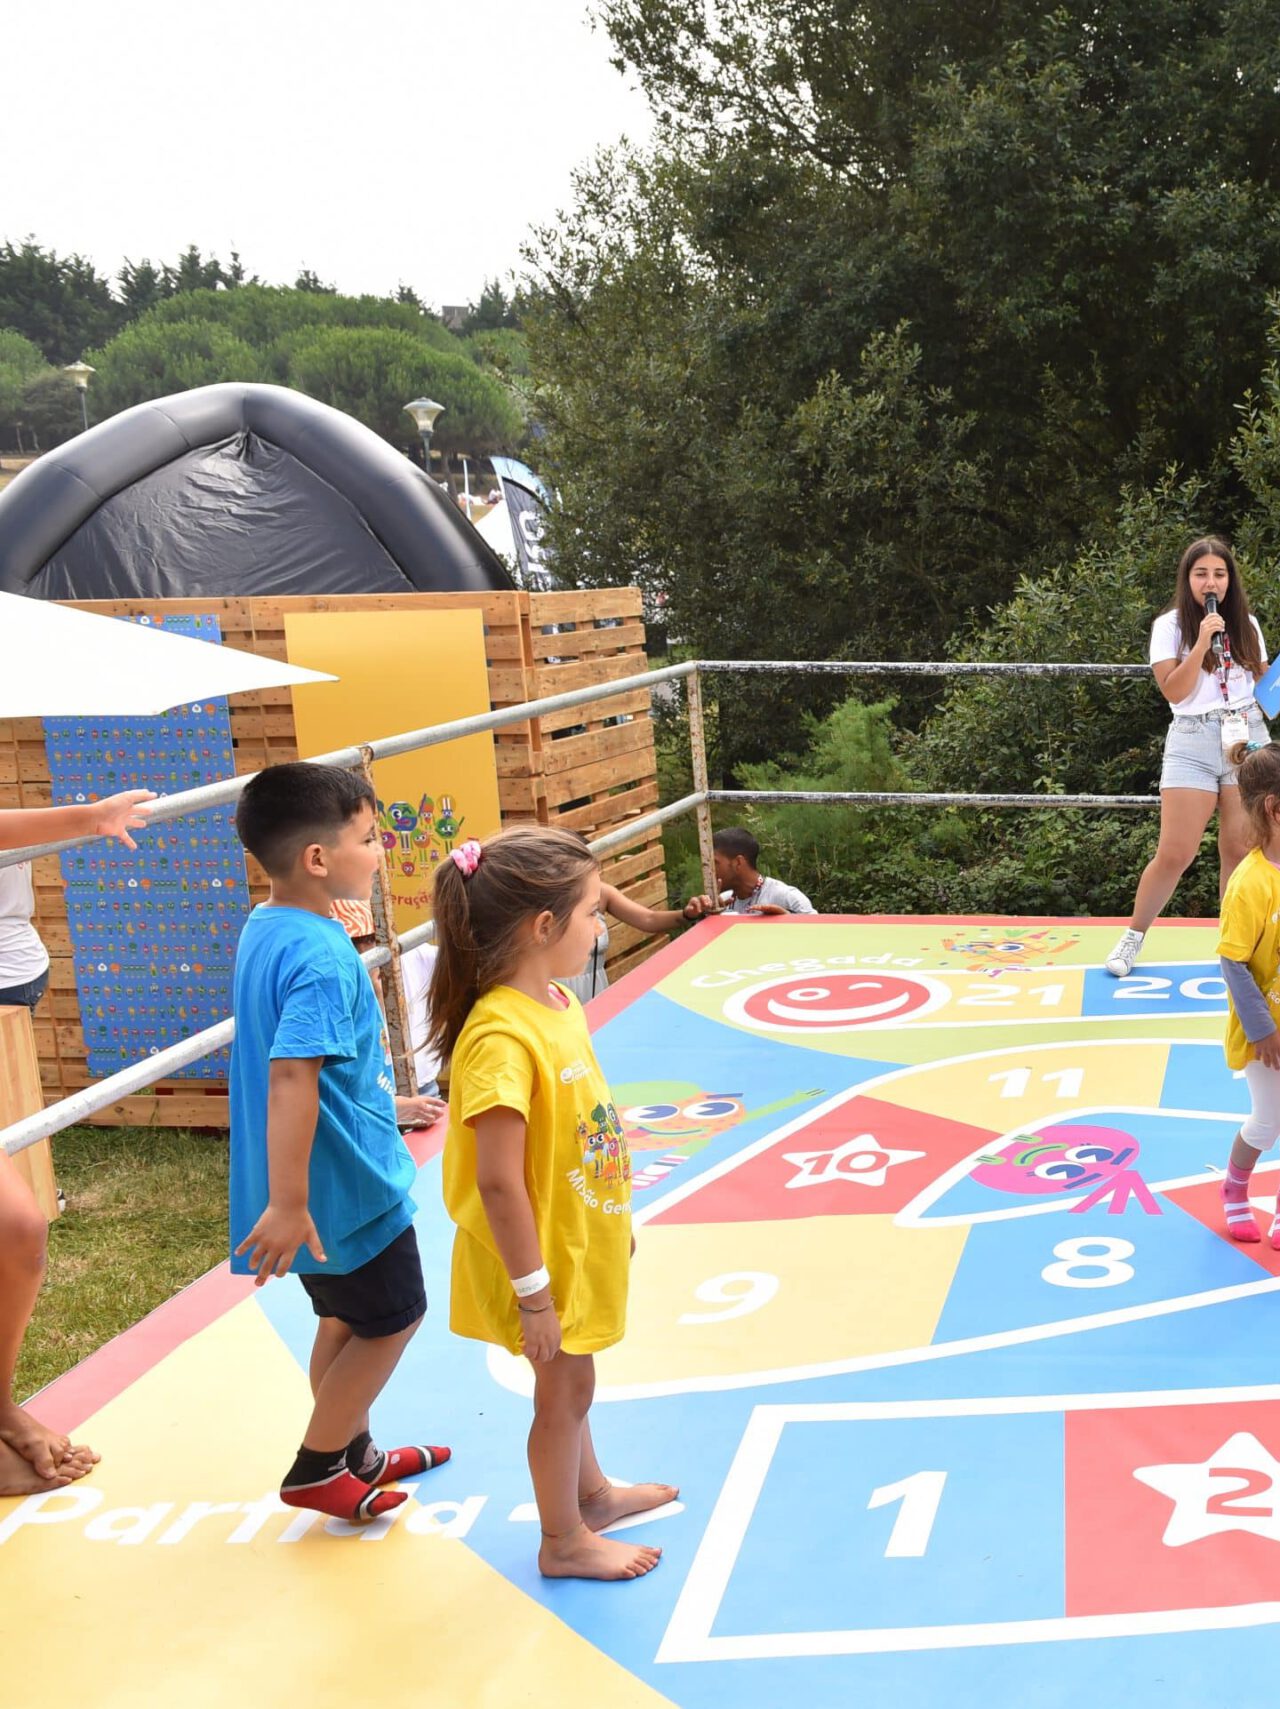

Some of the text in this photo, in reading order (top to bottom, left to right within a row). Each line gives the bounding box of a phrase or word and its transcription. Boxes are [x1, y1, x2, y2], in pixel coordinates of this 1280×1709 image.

[691, 953, 924, 988] Chegada
[1112, 977, 1226, 999] 20
[956, 983, 1064, 1005] 21
[987, 1068, 1084, 1098] 11
[802, 1150, 894, 1176] 10
[1041, 1235, 1135, 1288] 8
[678, 1271, 779, 1324] 9
[1205, 1467, 1273, 1517] 2
[0, 1482, 488, 1545] Partida
[867, 1470, 948, 1557] 1
